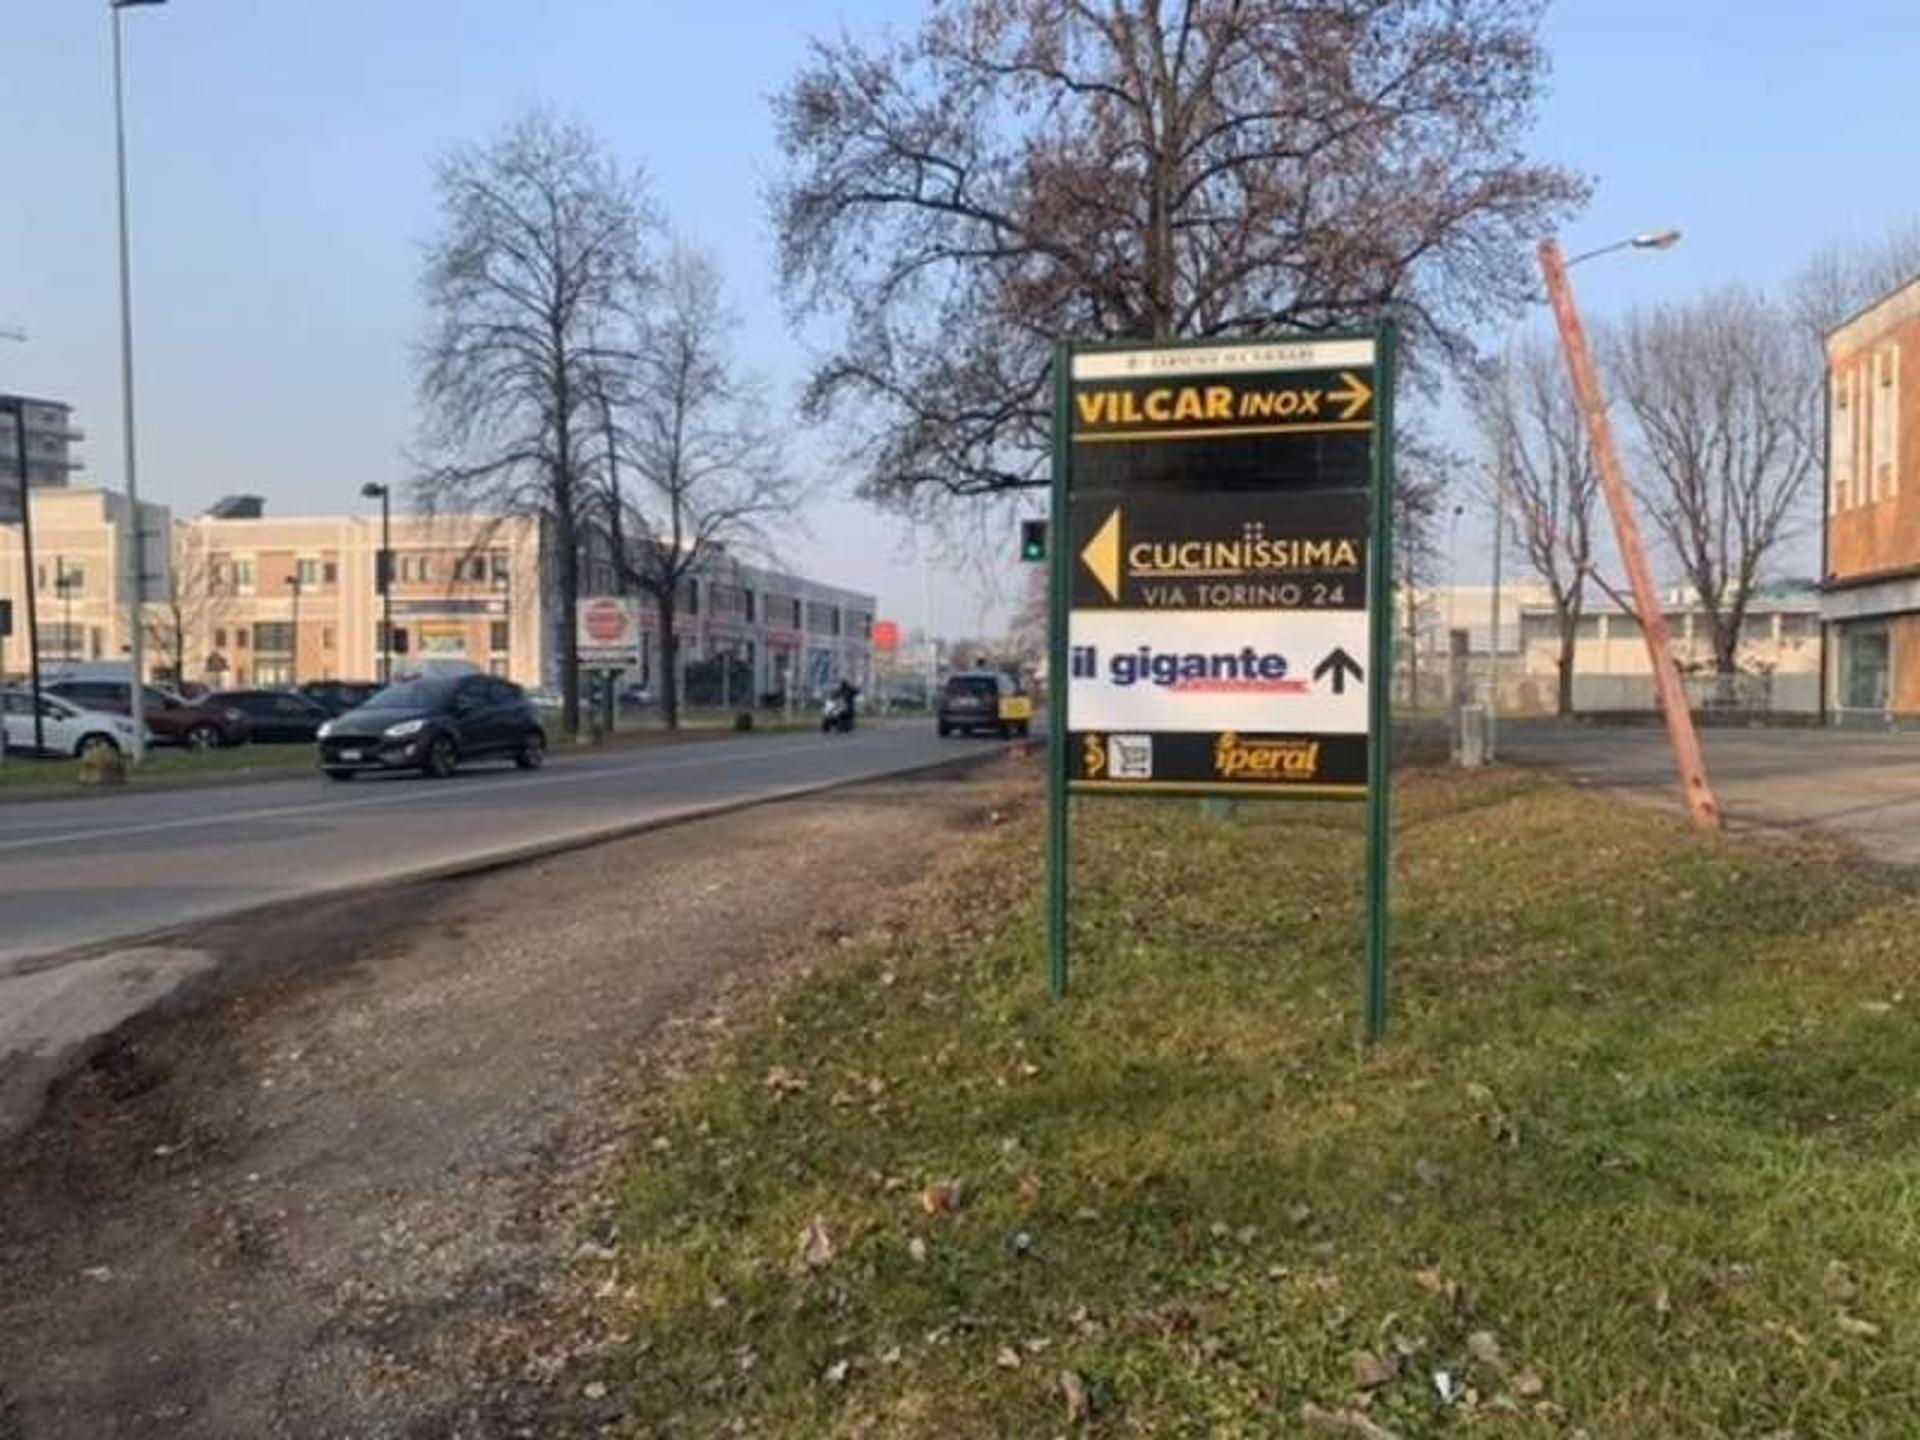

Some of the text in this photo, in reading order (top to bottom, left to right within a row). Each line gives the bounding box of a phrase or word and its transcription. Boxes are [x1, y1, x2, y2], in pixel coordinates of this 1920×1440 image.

[1077, 386, 1323, 423] VILCAR INOX
[1129, 538, 1358, 570] CUCINISSIMA
[1141, 583, 1345, 606] VIA TORINO 24
[1073, 645, 1288, 686] il gigante
